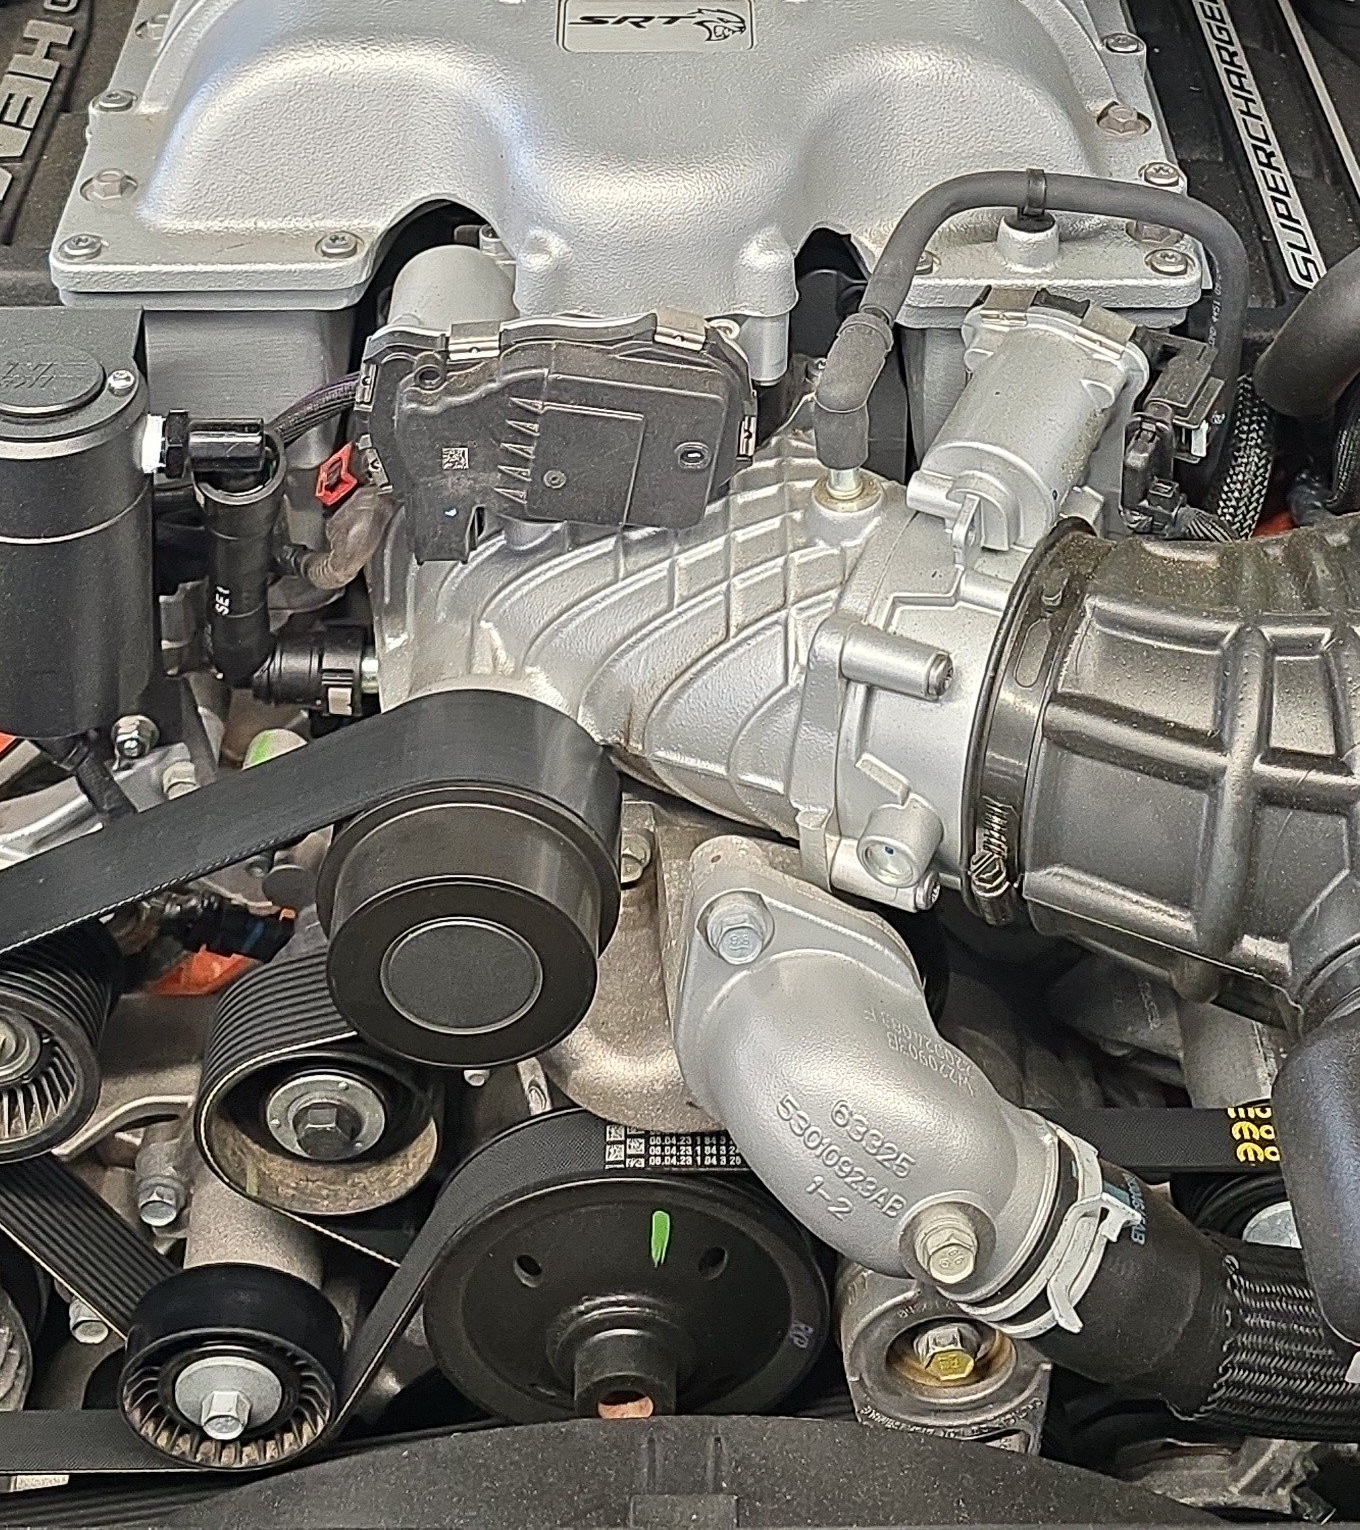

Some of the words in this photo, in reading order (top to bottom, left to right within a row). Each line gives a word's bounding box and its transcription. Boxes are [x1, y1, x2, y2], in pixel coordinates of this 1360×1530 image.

[568, 15, 697, 29] SRT
[776, 1094, 907, 1219] 53010923AB
[831, 1099, 917, 1179] 63325
[804, 1173, 854, 1222] 1-2
